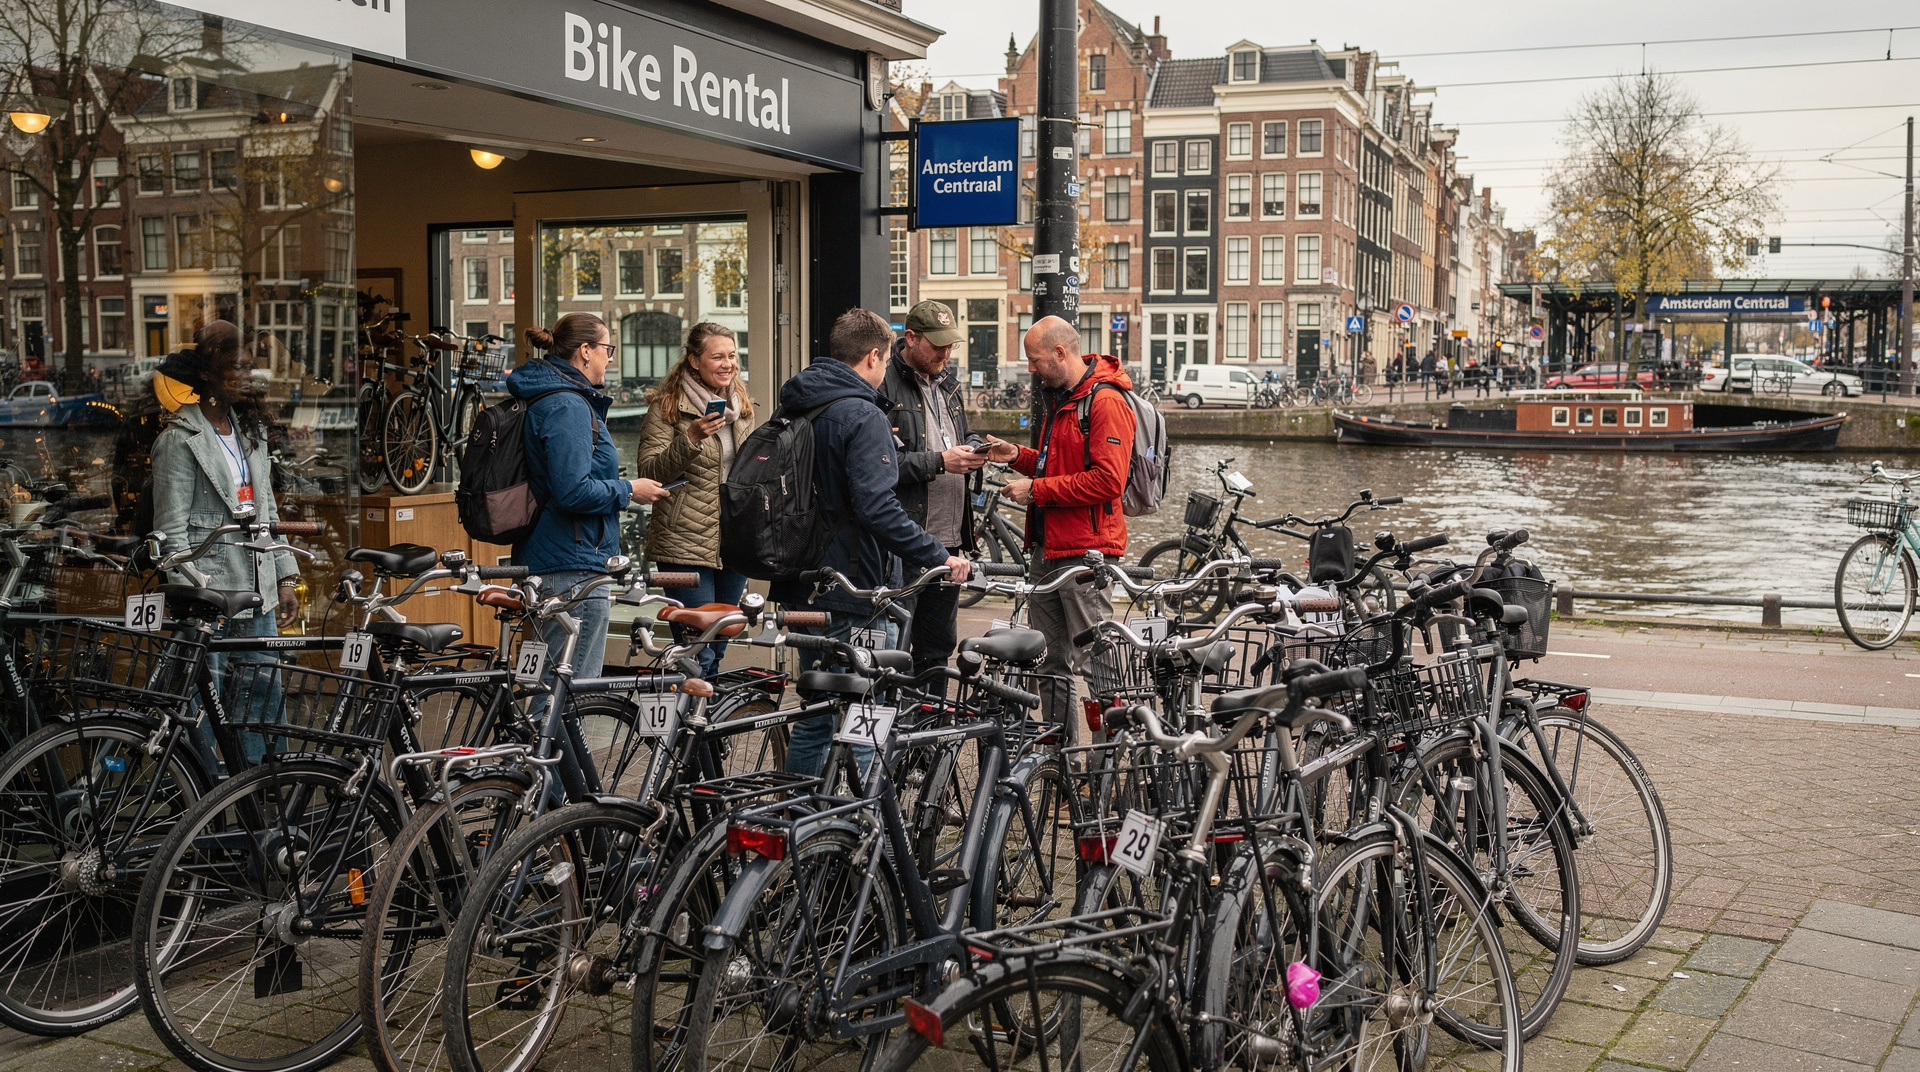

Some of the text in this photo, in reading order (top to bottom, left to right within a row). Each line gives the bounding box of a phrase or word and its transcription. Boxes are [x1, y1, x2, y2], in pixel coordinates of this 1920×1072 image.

[564, 11, 791, 135] Bike Rental
[921, 155, 1014, 175] Amsterdam
[1659, 297, 1731, 310] Amsterdam
[131, 604, 157, 627] 26
[348, 643, 363, 664] 19
[649, 705, 667, 728] 19
[848, 715, 881, 738] 27
[1122, 828, 1151, 861] 29
